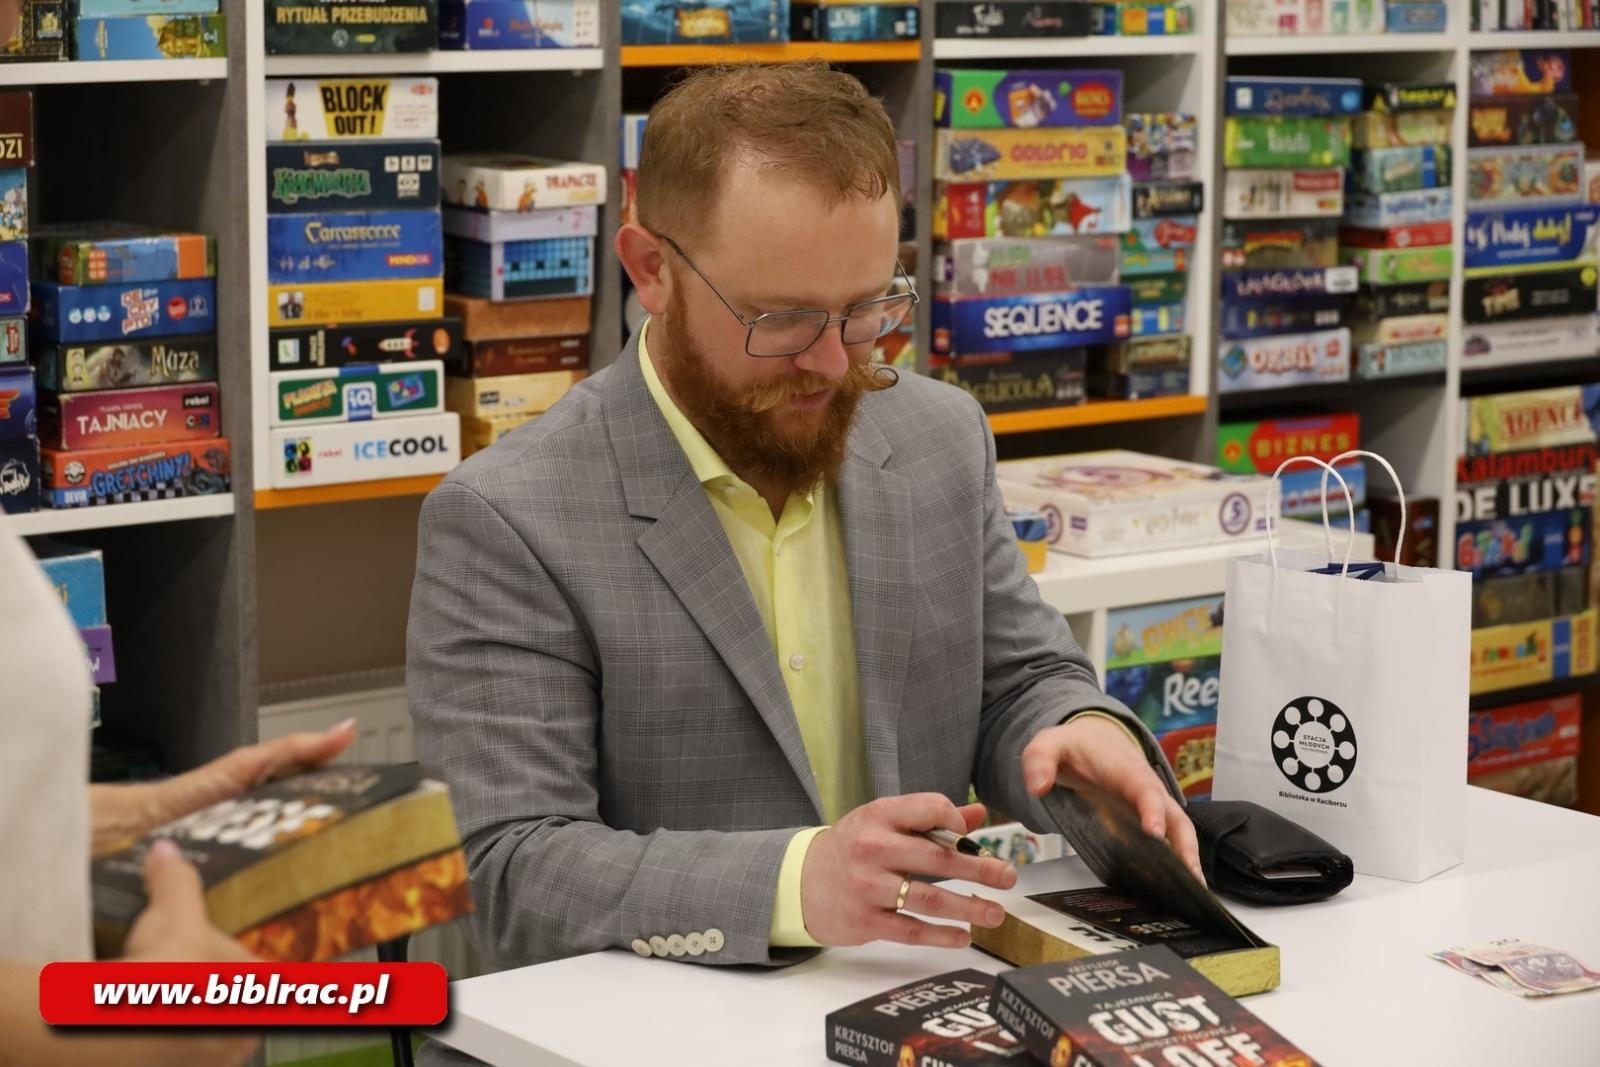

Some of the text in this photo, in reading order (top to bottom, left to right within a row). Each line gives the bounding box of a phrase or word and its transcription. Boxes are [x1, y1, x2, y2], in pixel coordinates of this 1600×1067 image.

[276, 6, 428, 24] RYTUAŁ PRZEBUDZENIA
[321, 83, 387, 113] BLOCK
[984, 299, 1104, 338] SEQUENCE
[76, 409, 168, 435] TAJNIACY
[1456, 475, 1596, 523] DE LUXE
[1163, 671, 1220, 717] Ree
[1299, 741, 1330, 750] MŁODYCH
[1303, 734, 1327, 743] STACJA
[1278, 791, 1309, 802] Biblioteka
[1048, 961, 1171, 998] PIERSA
[873, 980, 987, 1017] PIERSA
[921, 1001, 998, 1038] GU
[1087, 994, 1222, 1046] GUST
[834, 1024, 896, 1056] KRZYSZTOF
[834, 1042, 869, 1064] PIERSA
